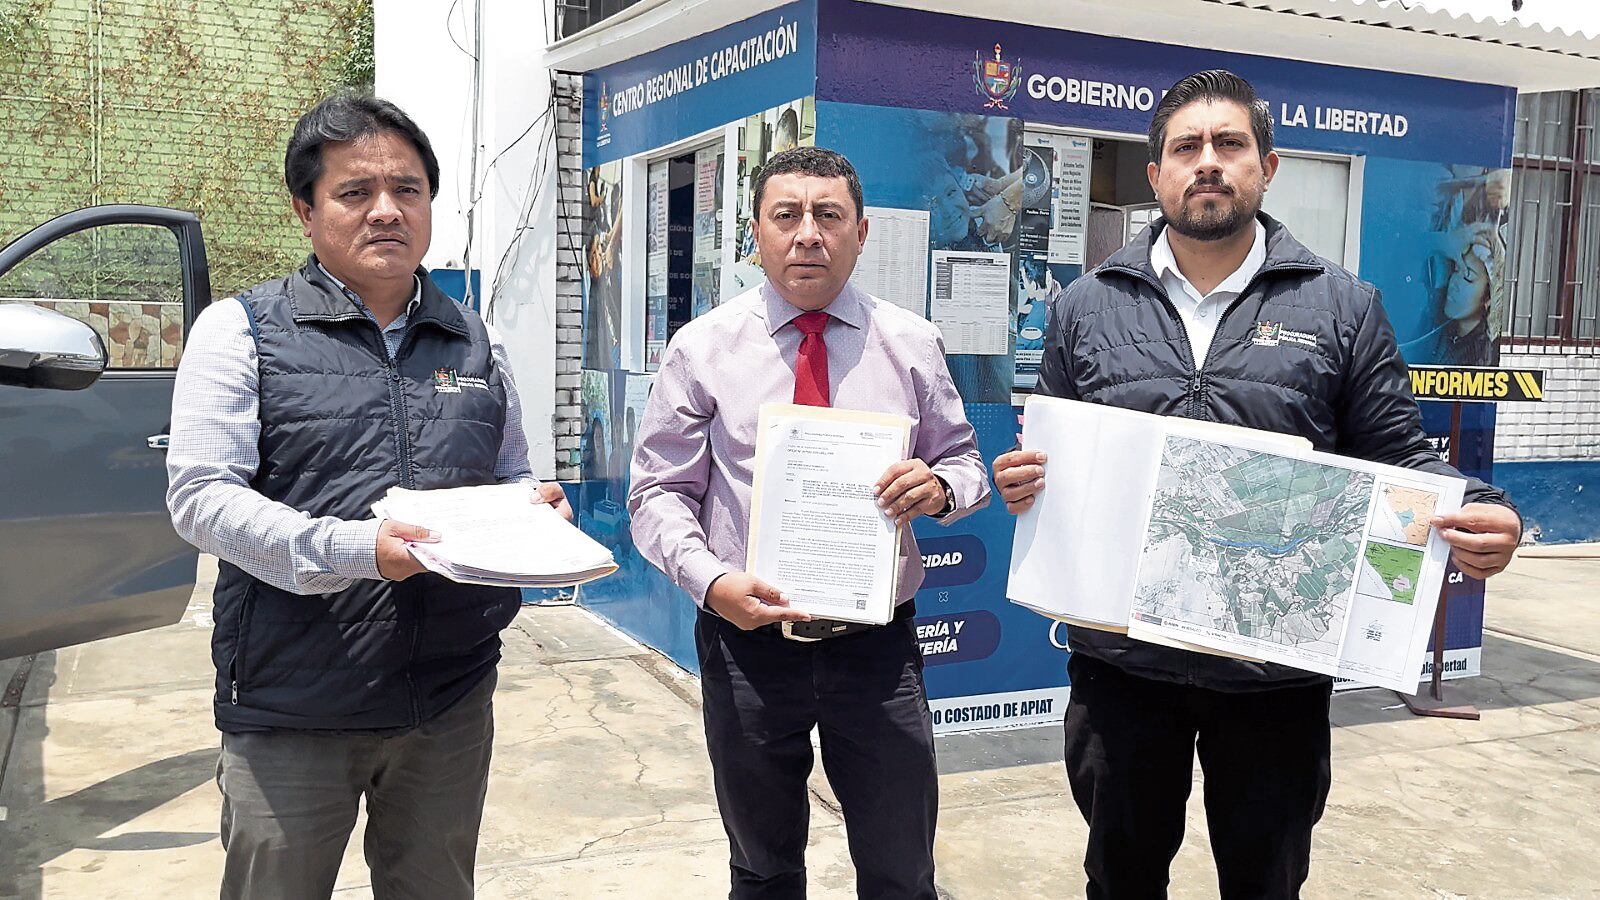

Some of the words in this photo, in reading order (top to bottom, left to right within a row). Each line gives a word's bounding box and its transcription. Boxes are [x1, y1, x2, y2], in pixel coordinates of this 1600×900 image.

[612, 82, 644, 117] CENTRO
[646, 68, 693, 105] REGIONAL
[695, 56, 709, 86] DE
[710, 16, 798, 80] CAPACITACIÓN
[1026, 73, 1154, 112] GOBIERNO
[1280, 102, 1308, 128] LA
[1314, 106, 1409, 138] LIBERTAD
[954, 620, 965, 634] Y
[945, 704, 1000, 724] COSTADO
[1004, 702, 1018, 718] DE
[1020, 699, 1053, 716] APIAT
